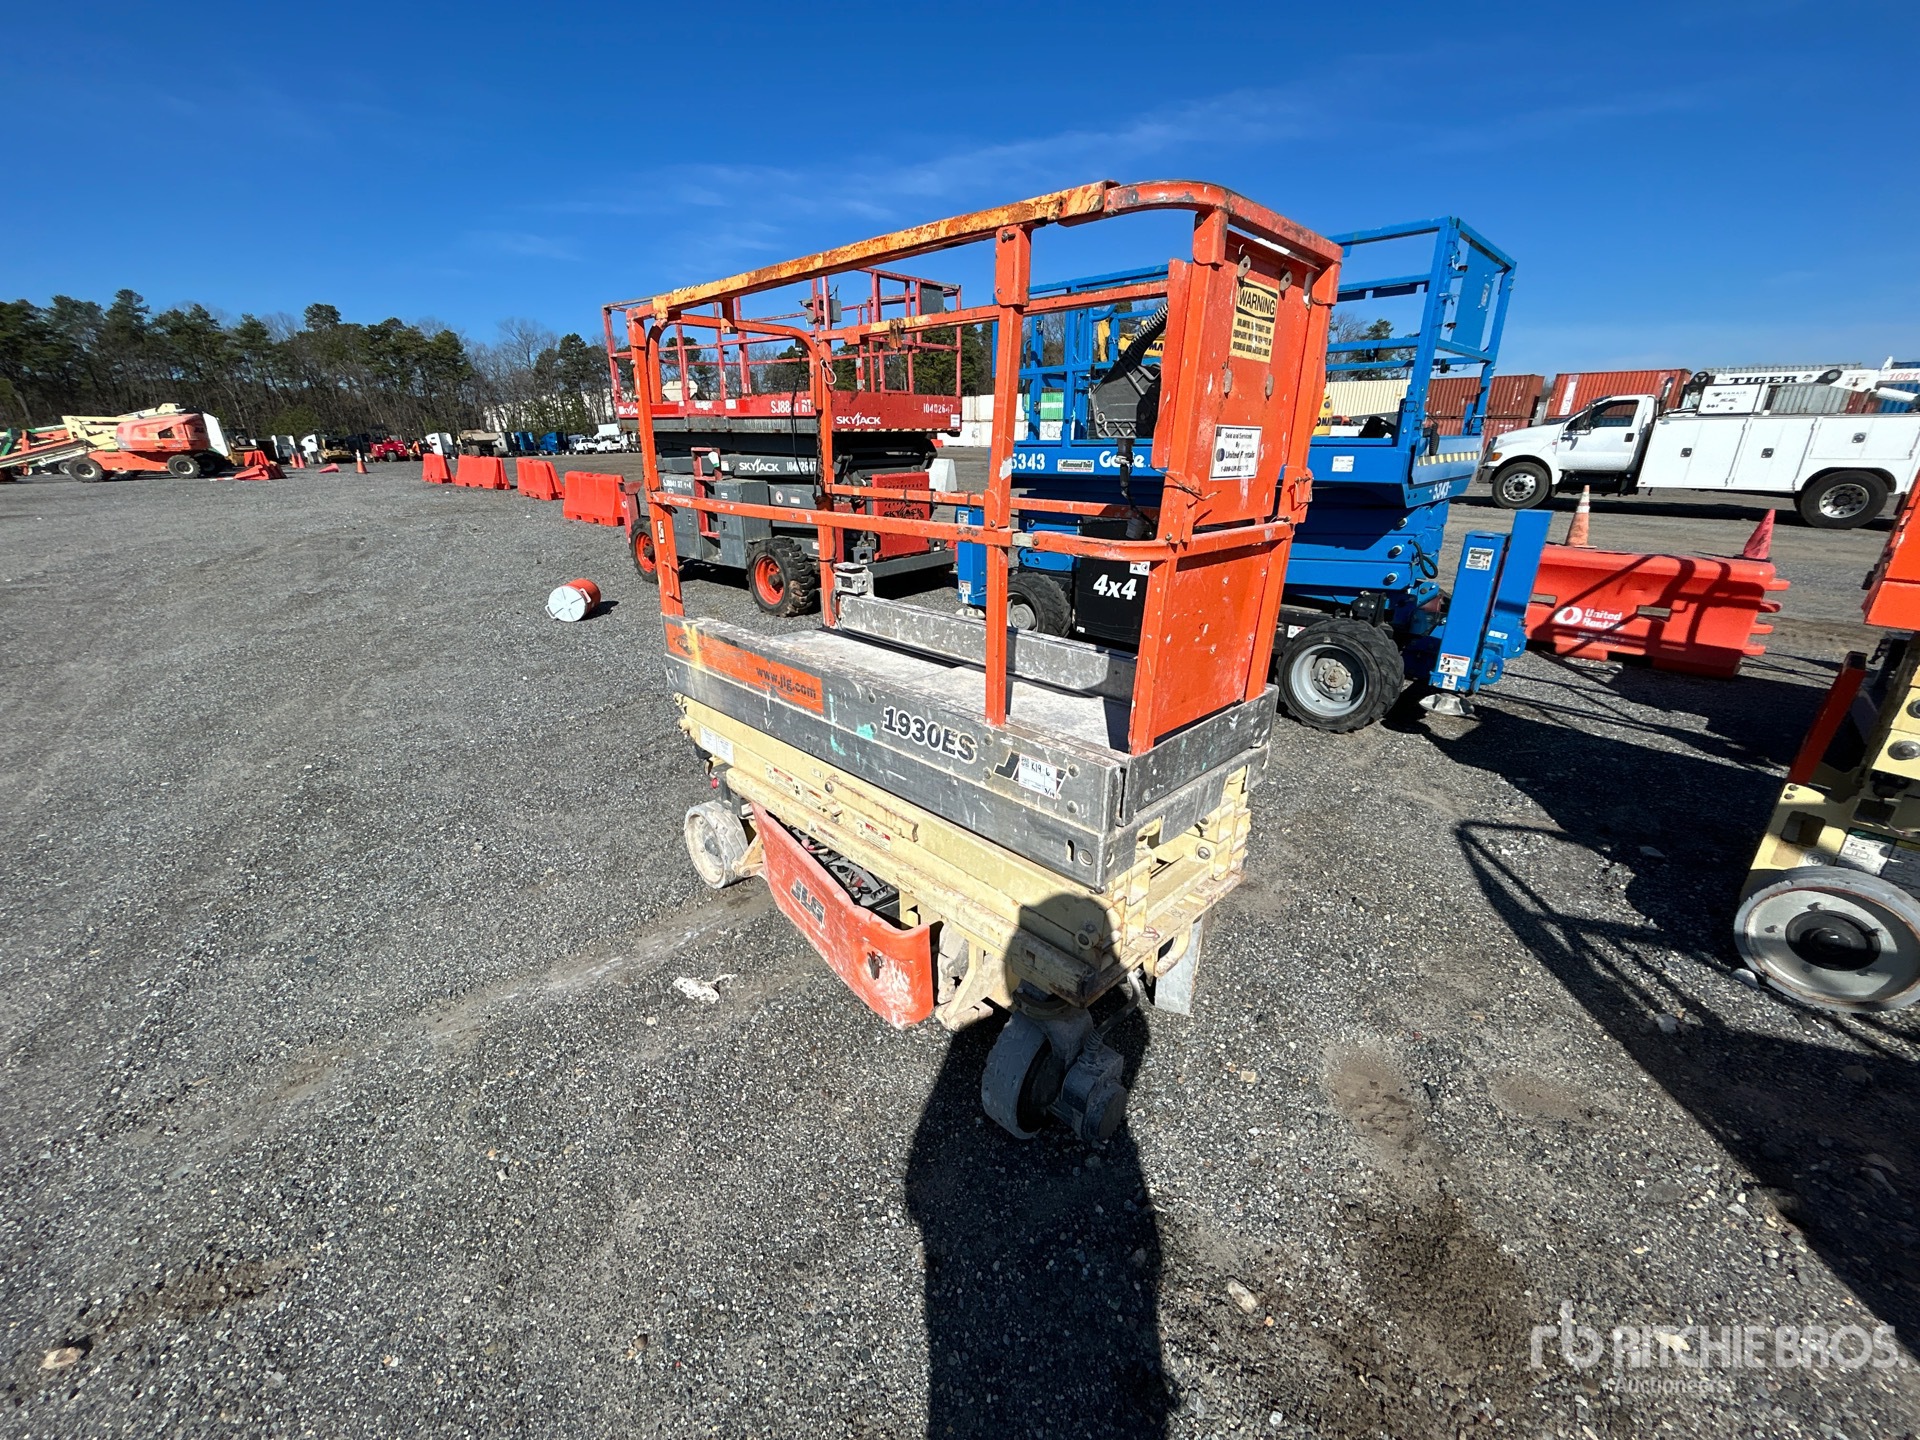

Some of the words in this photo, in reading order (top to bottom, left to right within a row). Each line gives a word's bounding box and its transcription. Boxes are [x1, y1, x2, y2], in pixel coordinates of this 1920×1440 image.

[1239, 290, 1275, 315] WARNING
[1730, 375, 1797, 384] TIGER
[836, 412, 881, 426] SKYJACK
[739, 458, 780, 473] SKYJACK
[1093, 574, 1137, 600] 4x4
[1585, 608, 1622, 620] United
[756, 667, 816, 699] www.jlg.com
[882, 705, 978, 765] 1930ES
